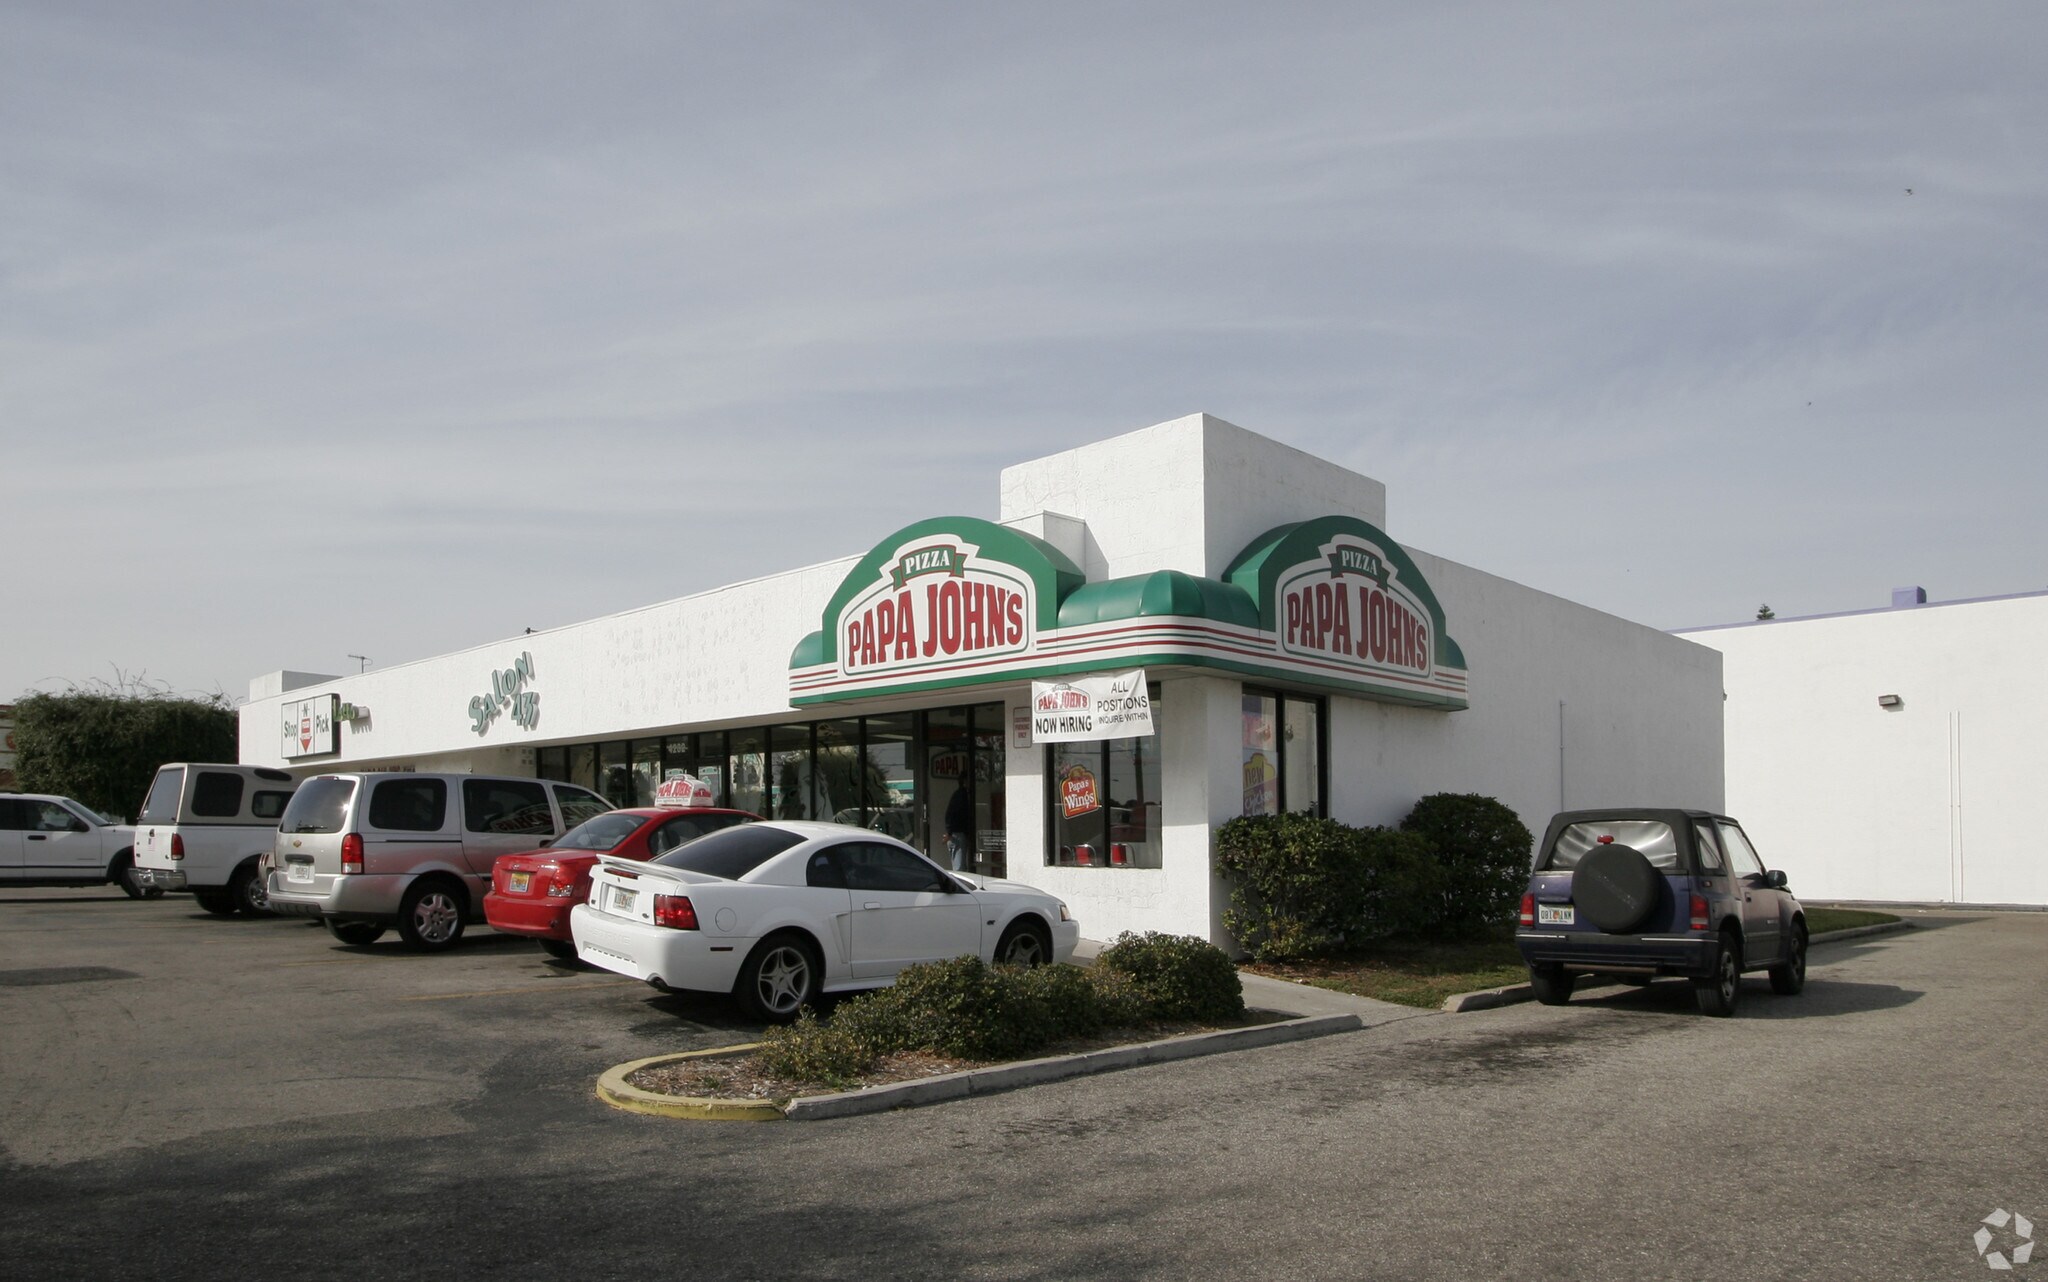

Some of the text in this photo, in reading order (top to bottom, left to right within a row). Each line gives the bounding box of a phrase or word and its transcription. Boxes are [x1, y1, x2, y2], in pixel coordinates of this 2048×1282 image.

[904, 548, 951, 575] PIZZA
[1340, 549, 1379, 577] PIZZA
[848, 580, 1023, 667] PAPA JOHN'S
[1287, 582, 1428, 671] PAPA JOHN'S
[1110, 680, 1129, 694] ALL
[511, 691, 535, 727] 43
[1097, 696, 1148, 713] POSITIONS
[316, 713, 330, 734] Pick
[1035, 715, 1093, 735] NOW HIRING
[1125, 712, 1149, 722] WITHIN
[1068, 779, 1089, 793] Papa's
[1065, 790, 1095, 809] Wings
